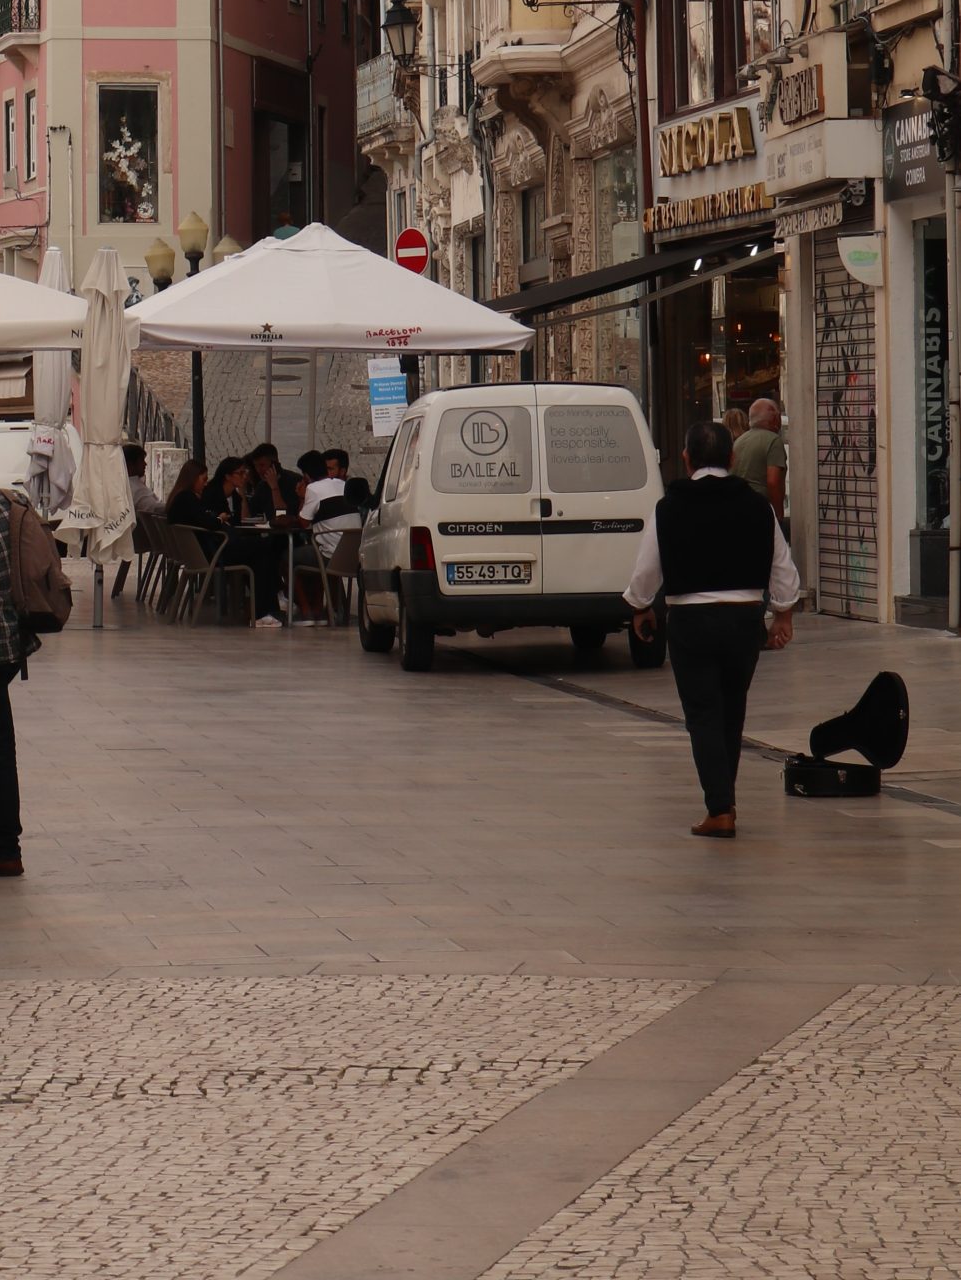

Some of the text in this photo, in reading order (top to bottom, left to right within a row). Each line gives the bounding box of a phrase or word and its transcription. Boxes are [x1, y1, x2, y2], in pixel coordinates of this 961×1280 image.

[778, 64, 823, 124] CRISTAL
[658, 107, 756, 177] NICOLA
[905, 166, 926, 187] COIMBRA
[250, 333, 283, 341] ESTRELLA
[365, 326, 422, 339] BARCELONA
[385, 338, 408, 347] 1876
[920, 307, 943, 462] CANNABIS
[550, 425, 609, 439] be socially
[450, 461, 521, 478] BALEAL
[447, 521, 635, 534] CITROËN Berlingo
